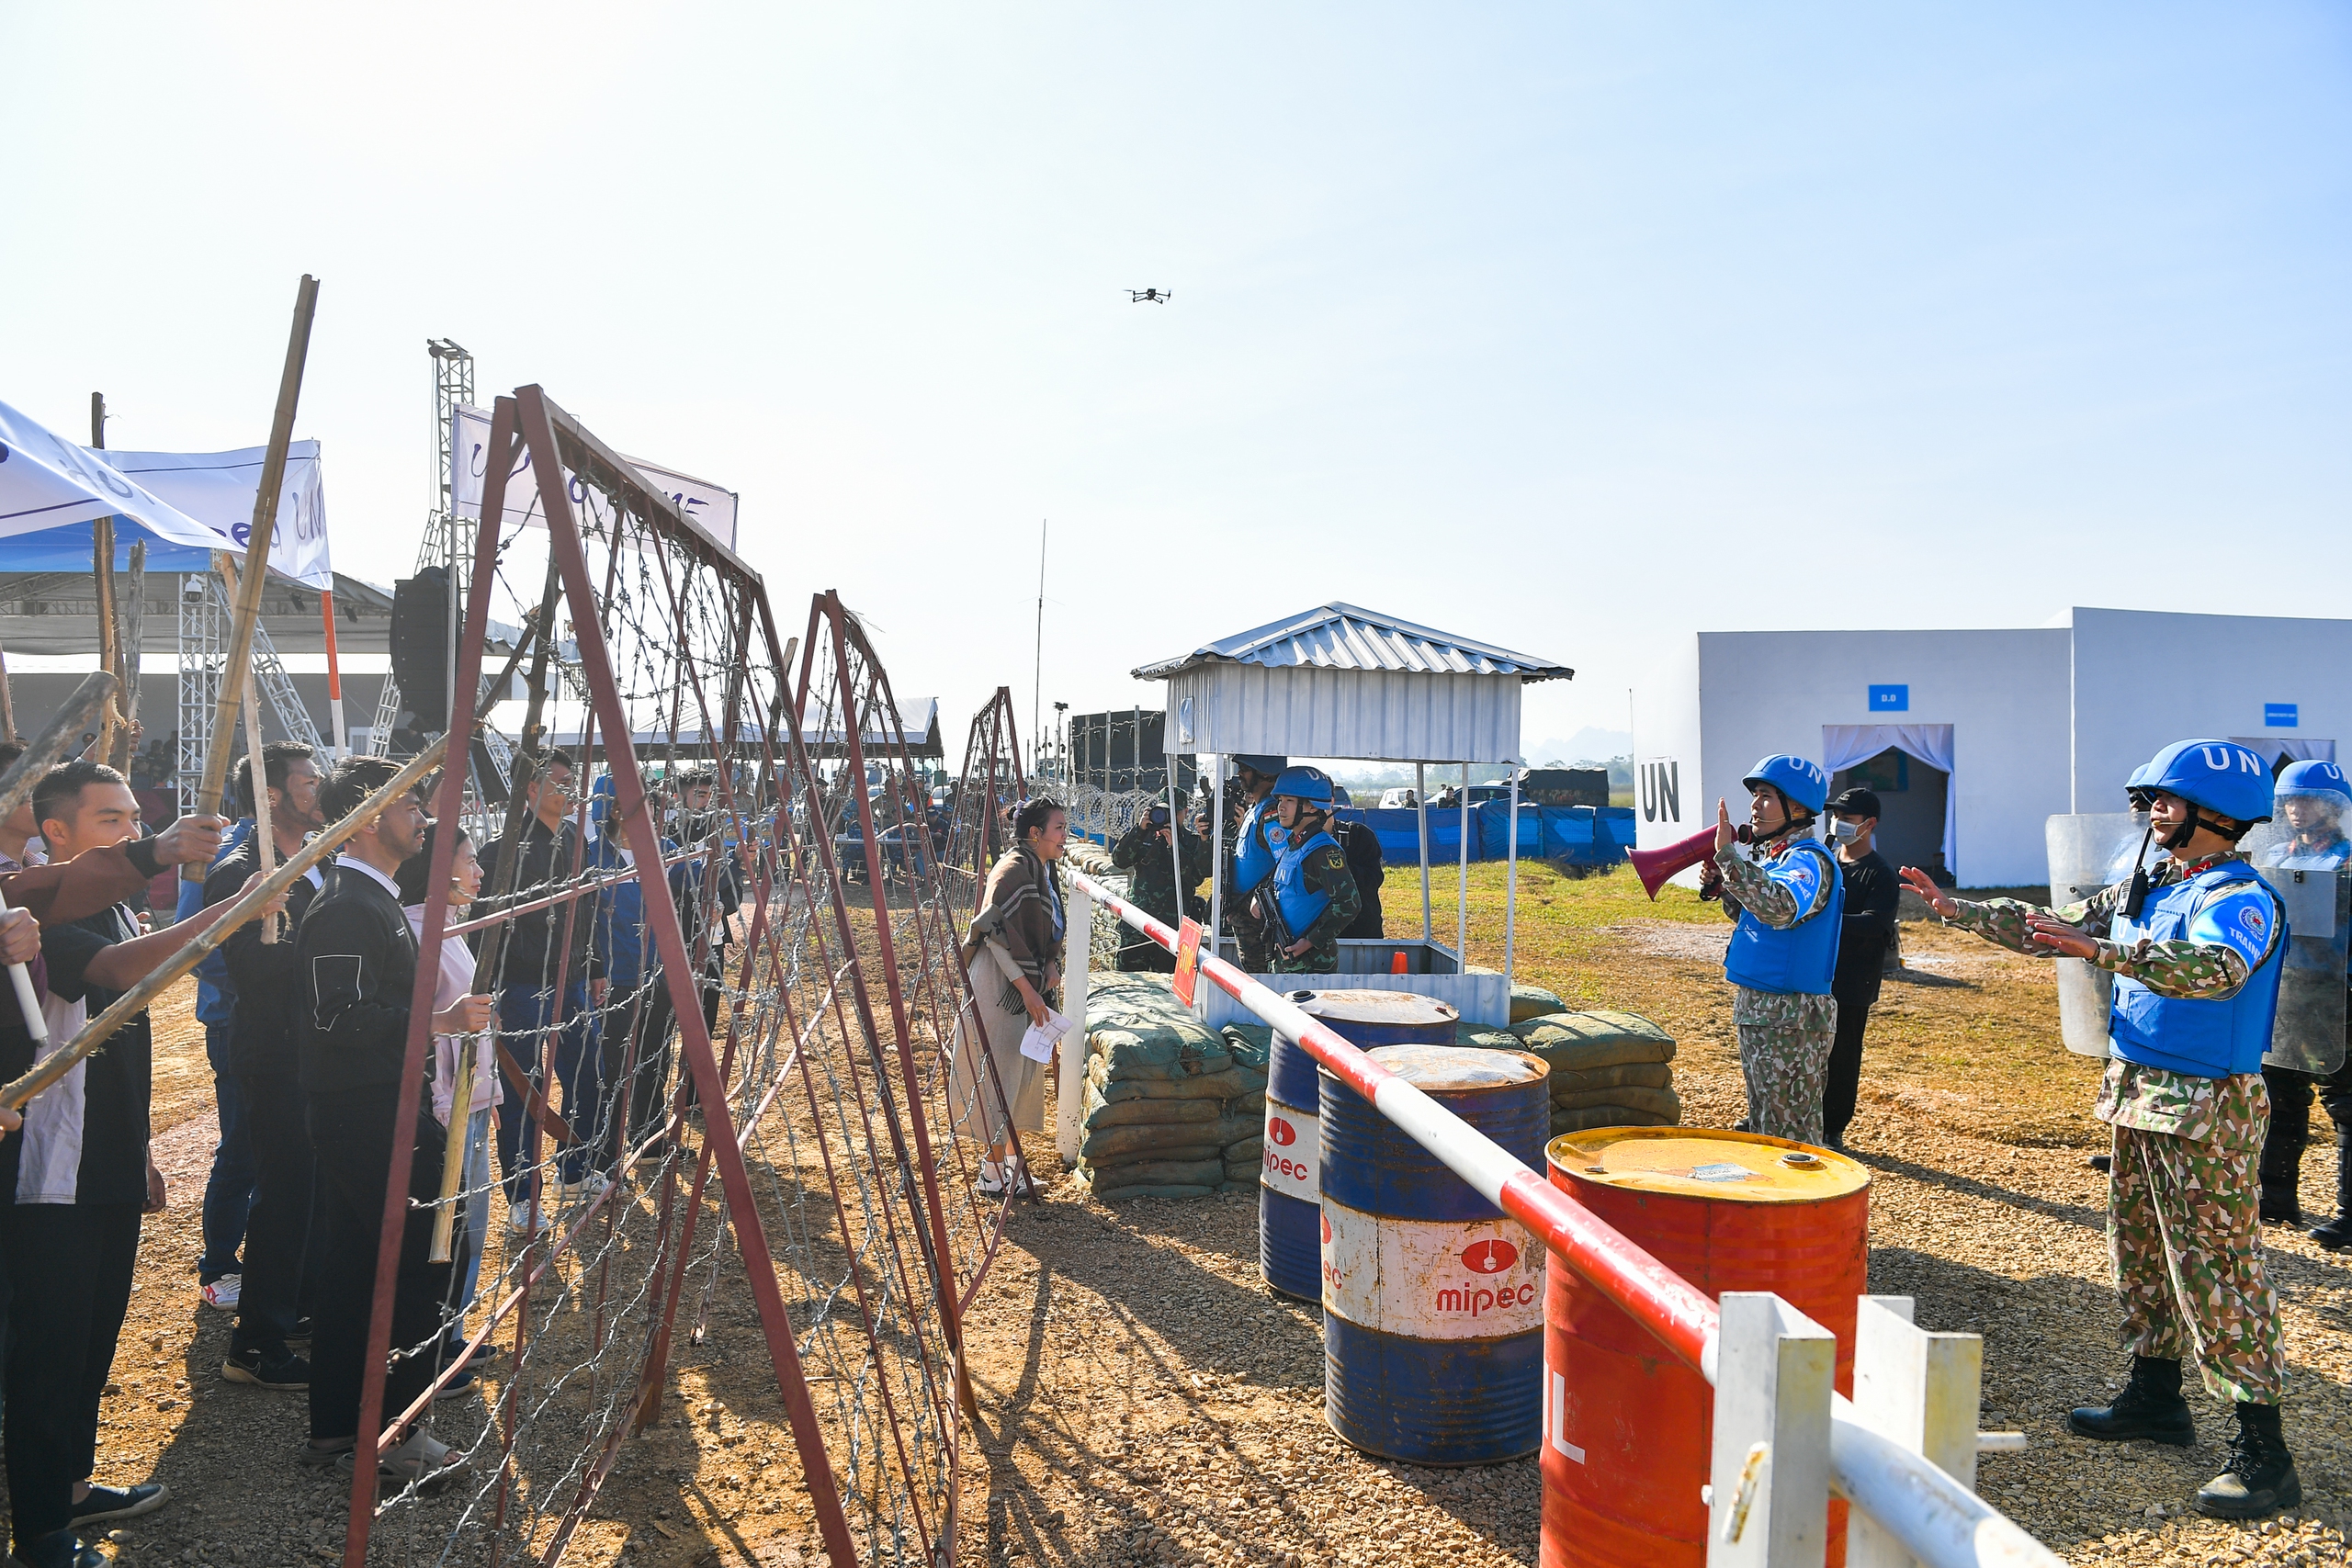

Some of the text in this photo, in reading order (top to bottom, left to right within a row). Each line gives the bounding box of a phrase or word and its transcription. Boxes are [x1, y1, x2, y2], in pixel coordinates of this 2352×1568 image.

[1788, 755, 1824, 785] UN
[2201, 747, 2261, 777] UN
[1641, 761, 1680, 823] UN
[1436, 1281, 1535, 1318] mipec
